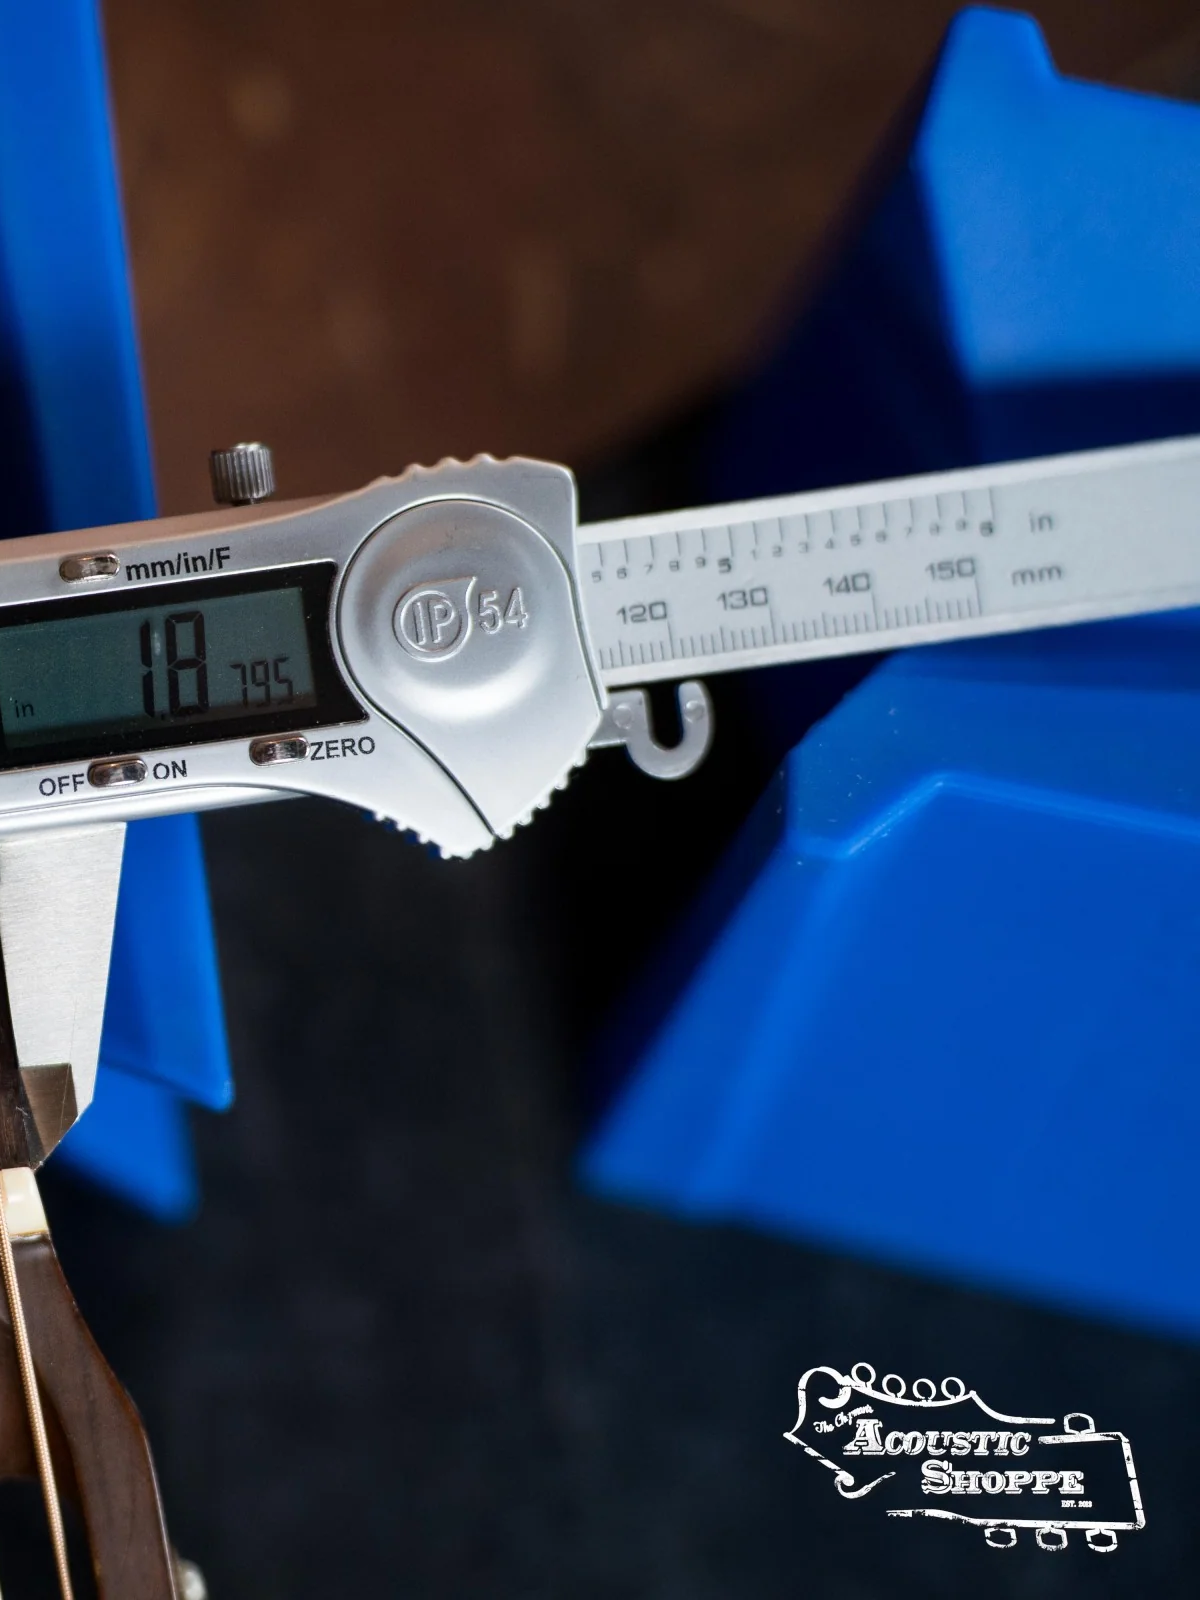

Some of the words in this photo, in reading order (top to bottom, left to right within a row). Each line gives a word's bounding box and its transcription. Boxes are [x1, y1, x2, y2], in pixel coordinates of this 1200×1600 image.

[126, 546, 231, 581] mm/in/F
[591, 570, 603, 583] 5
[616, 566, 628, 580] 6
[644, 562, 654, 574] 7
[668, 559, 681, 572] 8
[695, 556, 707, 568] 9
[717, 557, 733, 574] 5
[772, 545, 784, 558] 2
[798, 541, 811, 554] 3
[824, 537, 836, 550] 4
[849, 532, 863, 547] 5
[1028, 510, 1055, 535] in
[617, 600, 669, 625] 120
[717, 585, 770, 611] 130
[823, 571, 872, 595] 140
[925, 556, 977, 581] 150
[1011, 565, 1064, 585] mm
[411, 599, 456, 646] IP
[477, 587, 529, 635] 54
[14, 699, 35, 719] in
[309, 736, 375, 760] ZERO
[39, 773, 84, 796] OFF
[153, 760, 187, 779] ON
